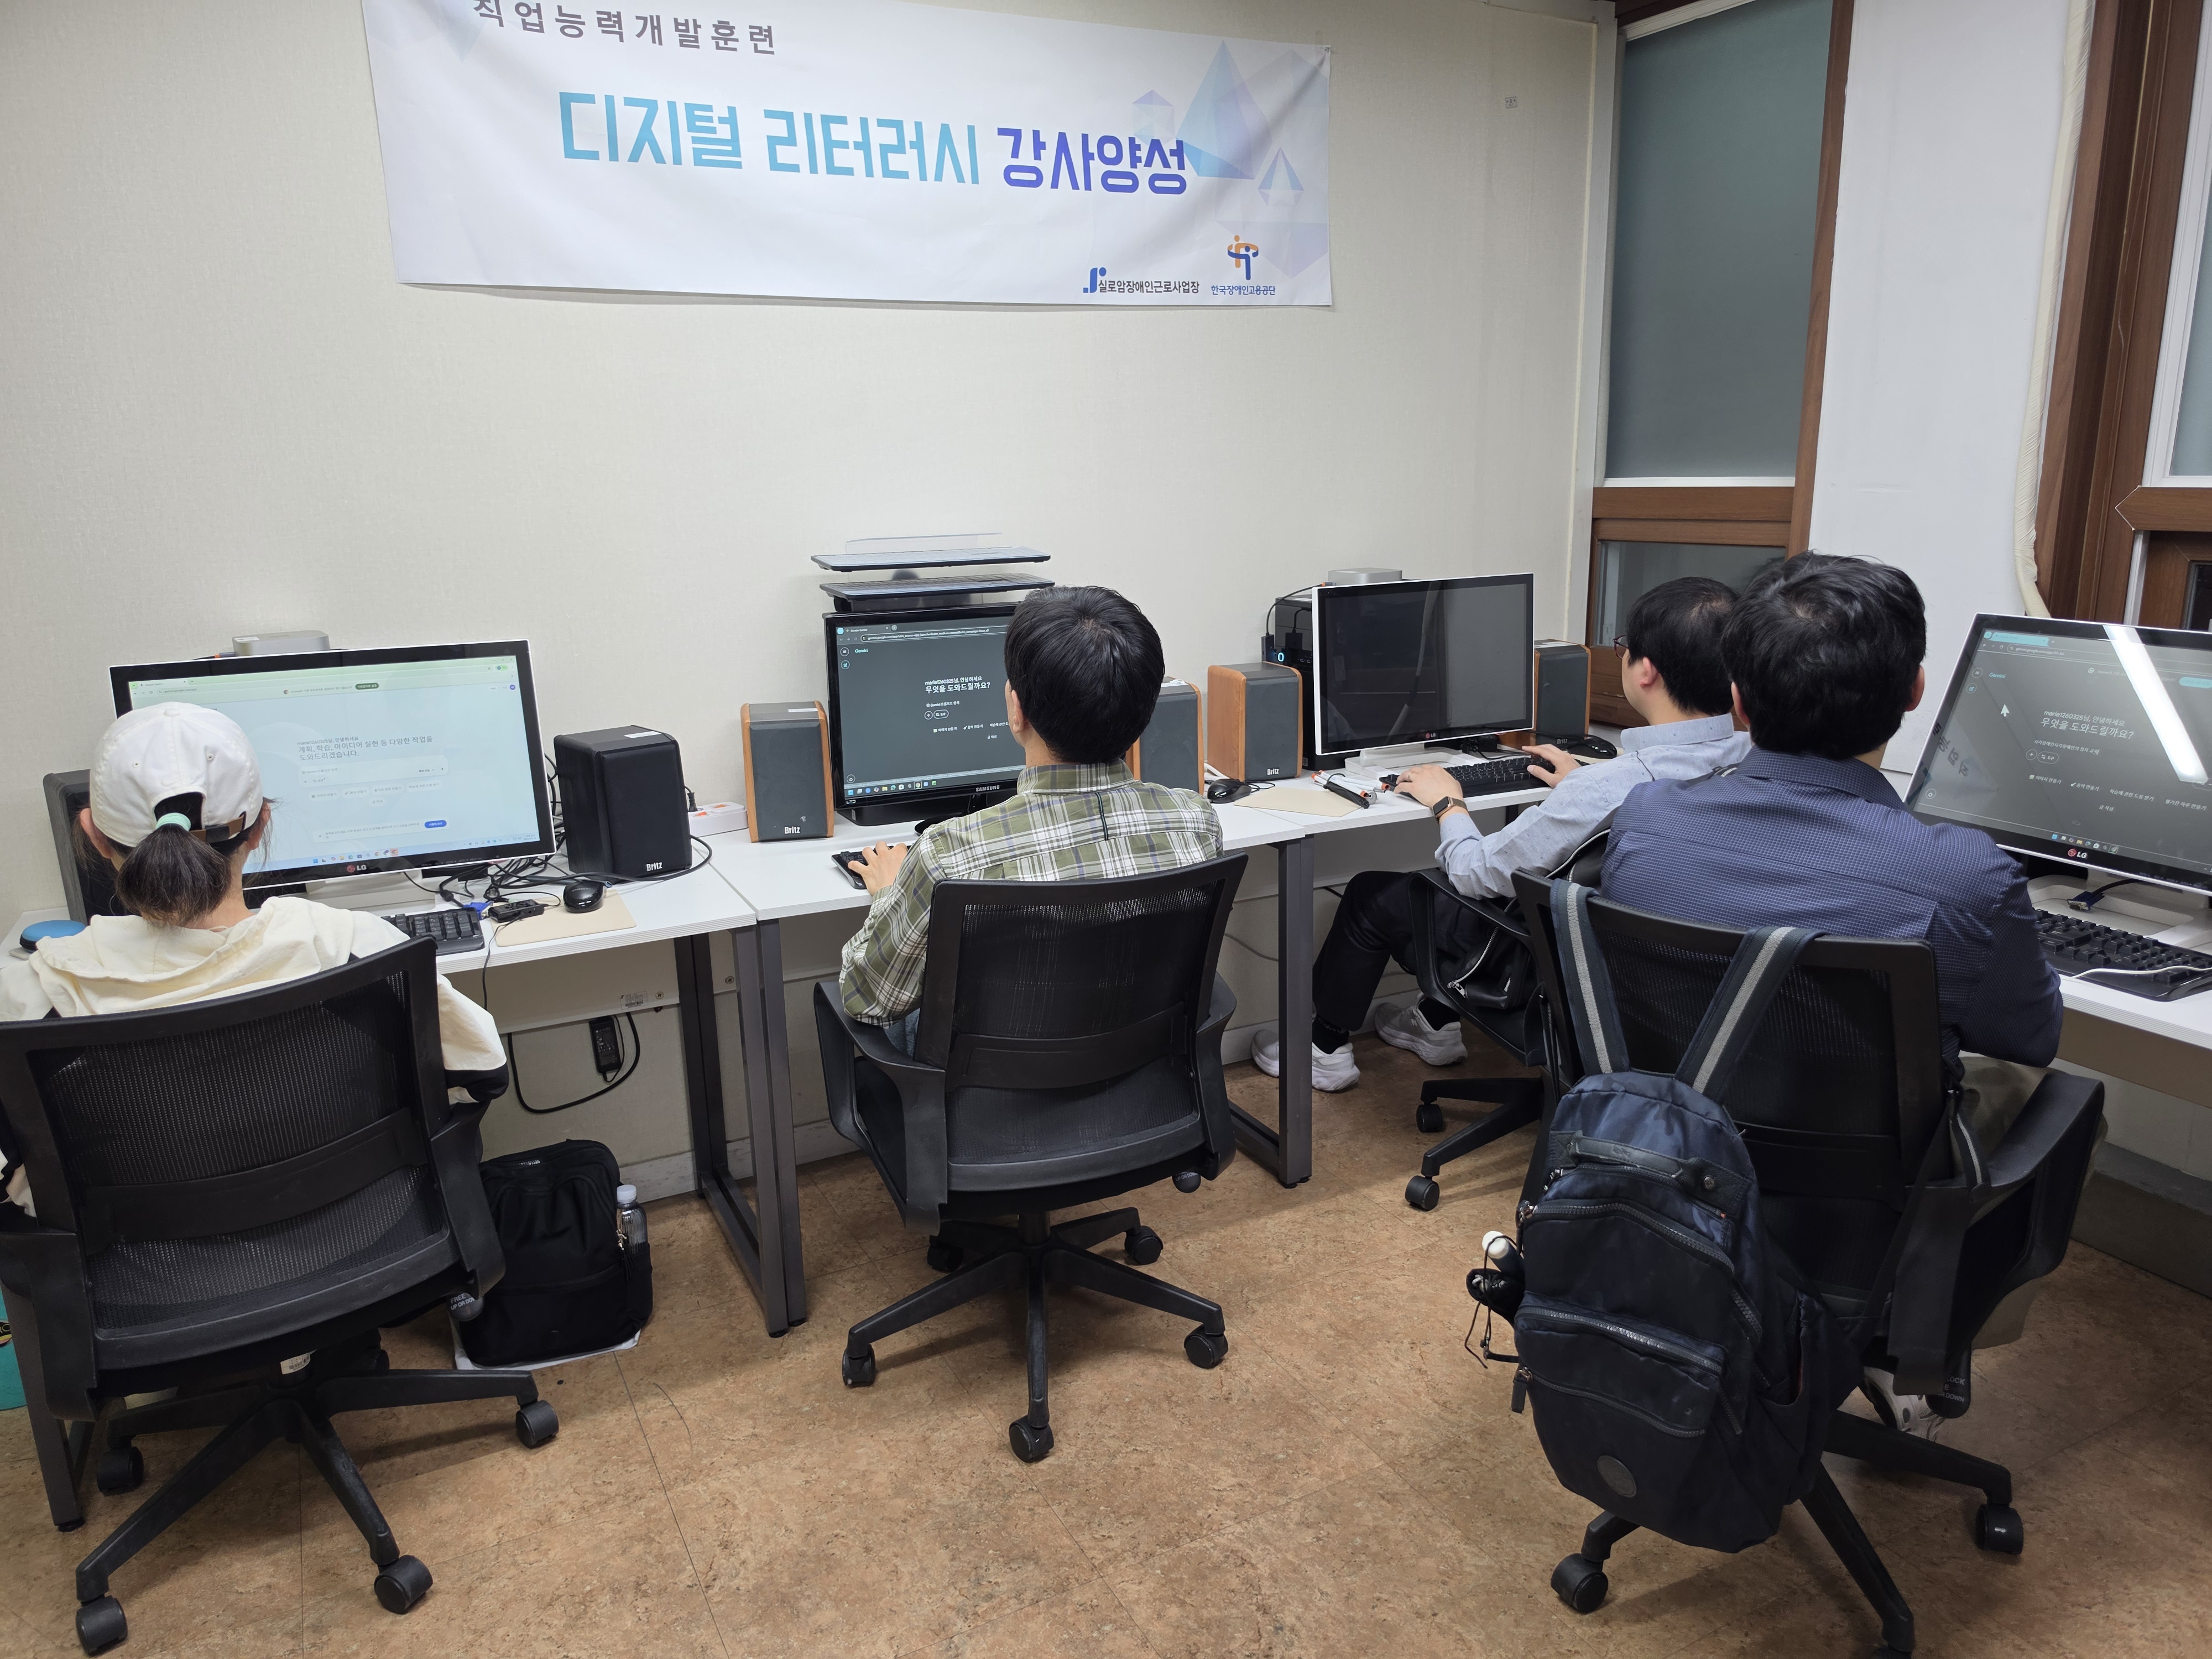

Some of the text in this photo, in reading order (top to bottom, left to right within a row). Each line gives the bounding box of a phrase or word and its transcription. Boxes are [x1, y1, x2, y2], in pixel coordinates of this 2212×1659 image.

[559, 92, 1187, 195] 디지털 리터러시 강사양성
[1098, 280, 1199, 294] 실로암장애인근로사업장
[1211, 285, 1276, 295] 한국장애인고용공단
[925, 682, 990, 693] 무엇을 도와드릴까요?
[2092, 716, 2125, 726] 안녕하세요
[2041, 717, 2135, 739] 무엇을 도와드릴까요?
[335, 742, 363, 750] 아이디어
[389, 737, 410, 746] 다양한
[412, 735, 433, 744] 작업을
[646, 862, 662, 872] Britz
[450, 1293, 466, 1304] FREE
[1945, 1393, 1965, 1403] DOWN
